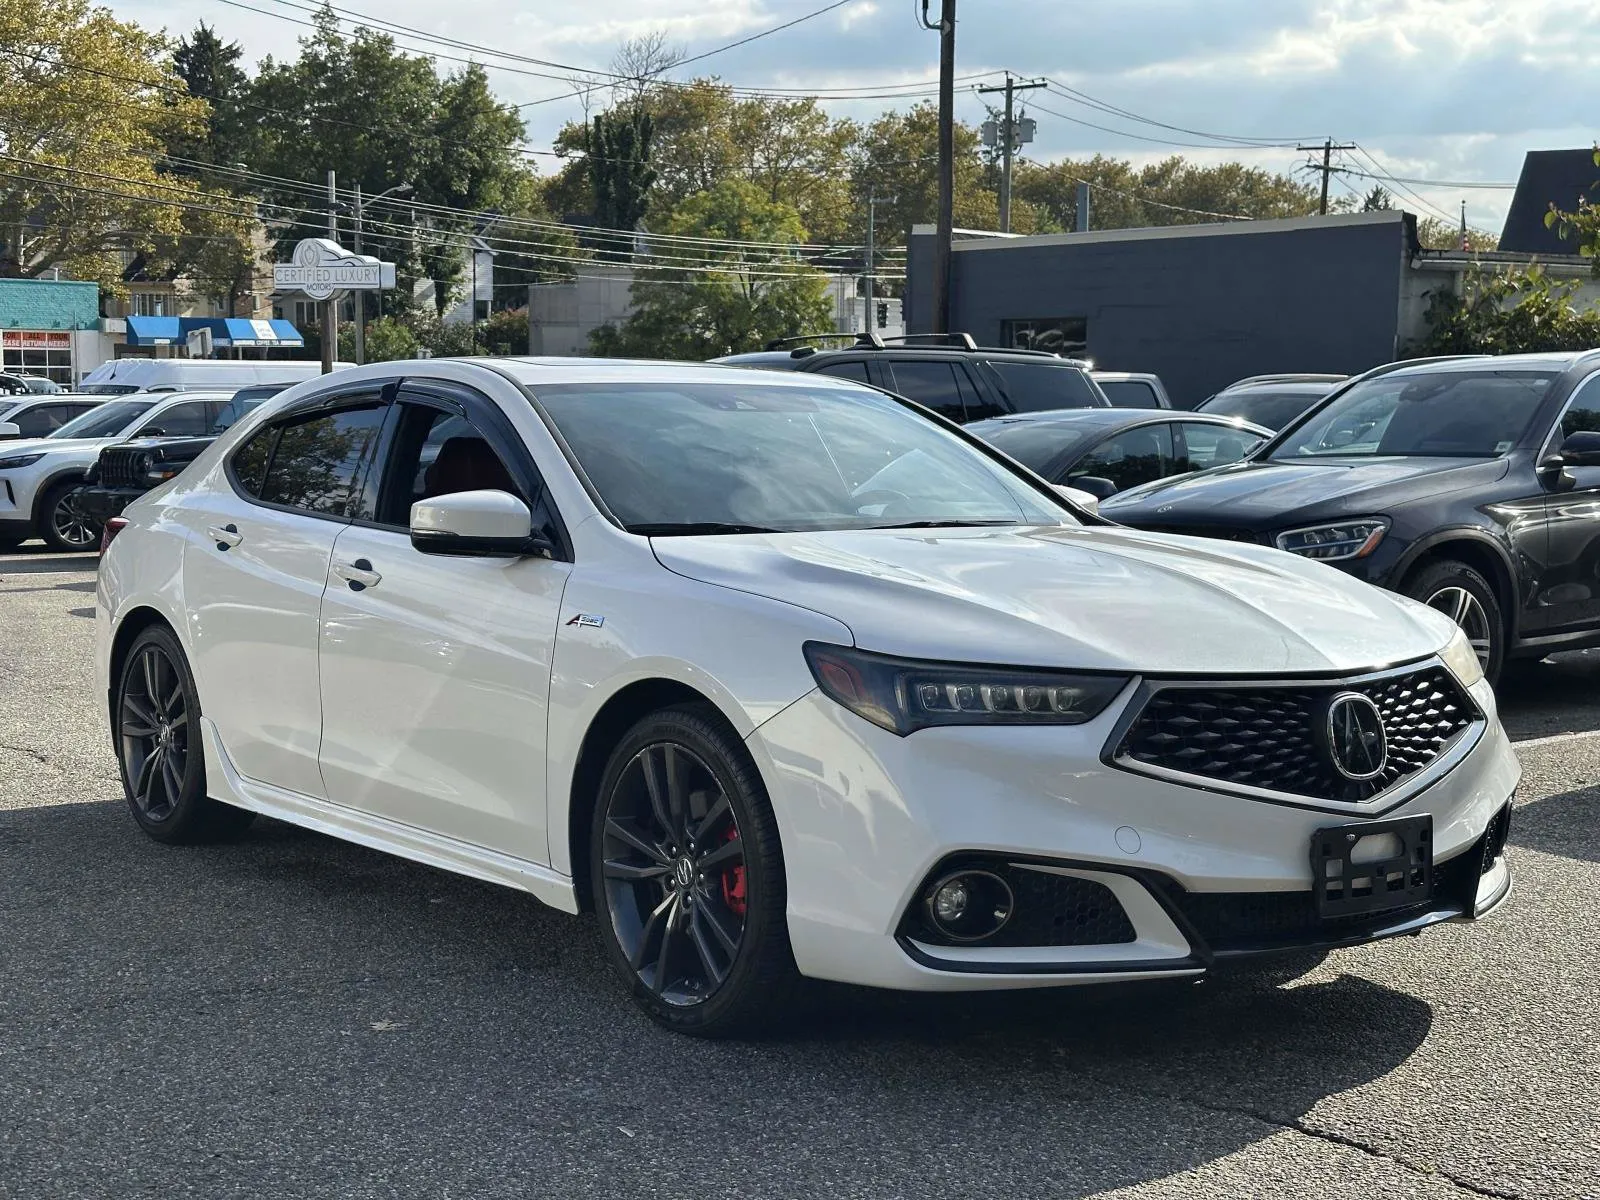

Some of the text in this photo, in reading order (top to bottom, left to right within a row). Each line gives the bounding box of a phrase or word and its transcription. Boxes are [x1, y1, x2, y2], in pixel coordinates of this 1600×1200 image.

[275, 268, 378, 282] CERTIFIED LUXURY
[306, 283, 331, 291] MOTORS
[3, 339, 20, 347] EASE
